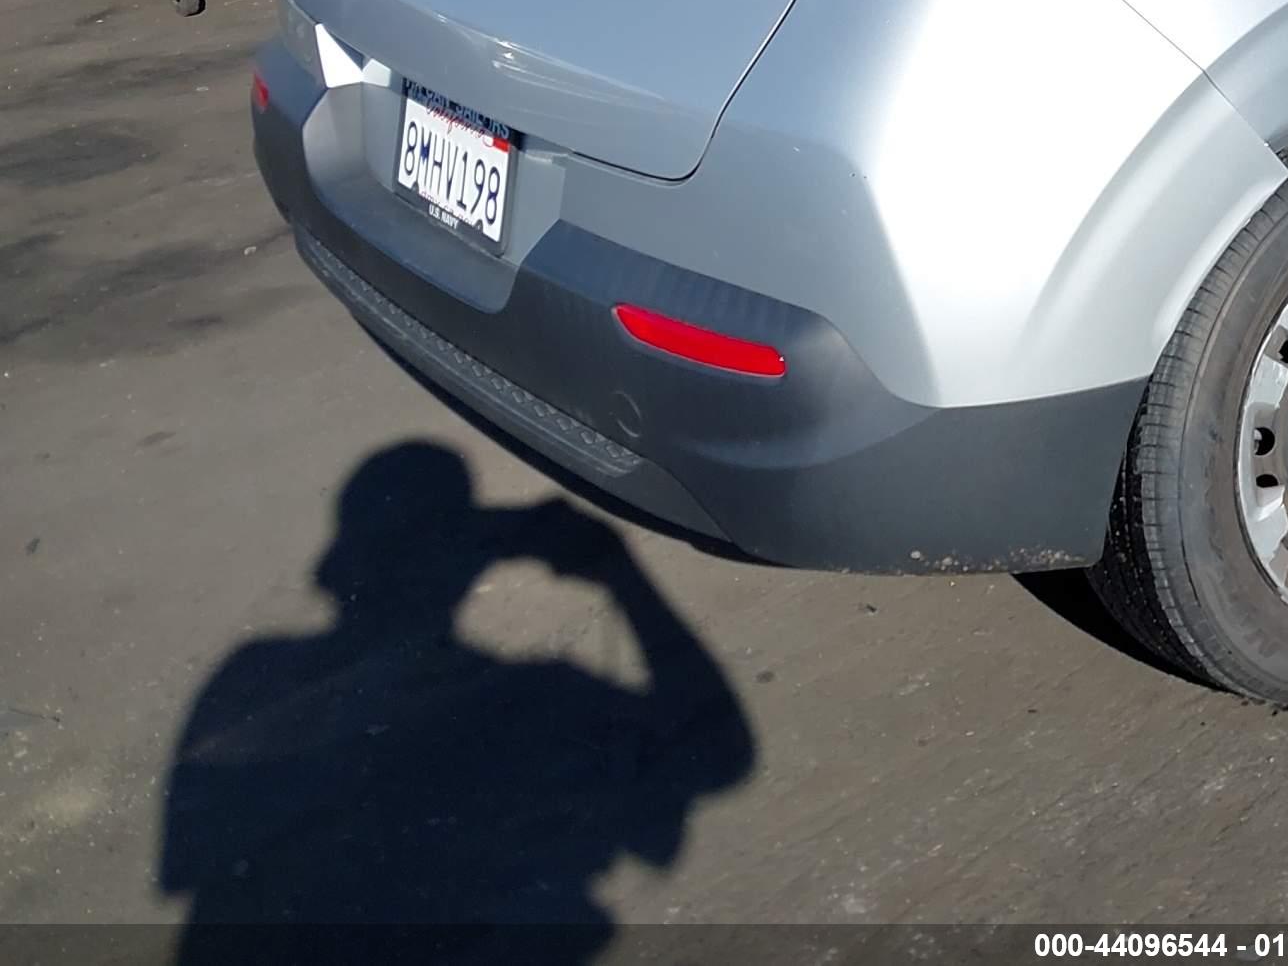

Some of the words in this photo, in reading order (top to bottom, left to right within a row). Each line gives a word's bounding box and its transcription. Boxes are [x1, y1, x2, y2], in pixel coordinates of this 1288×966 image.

[403, 120, 501, 226] 8MHV198
[428, 203, 441, 220] U.S.
[440, 211, 459, 230] NAVY
